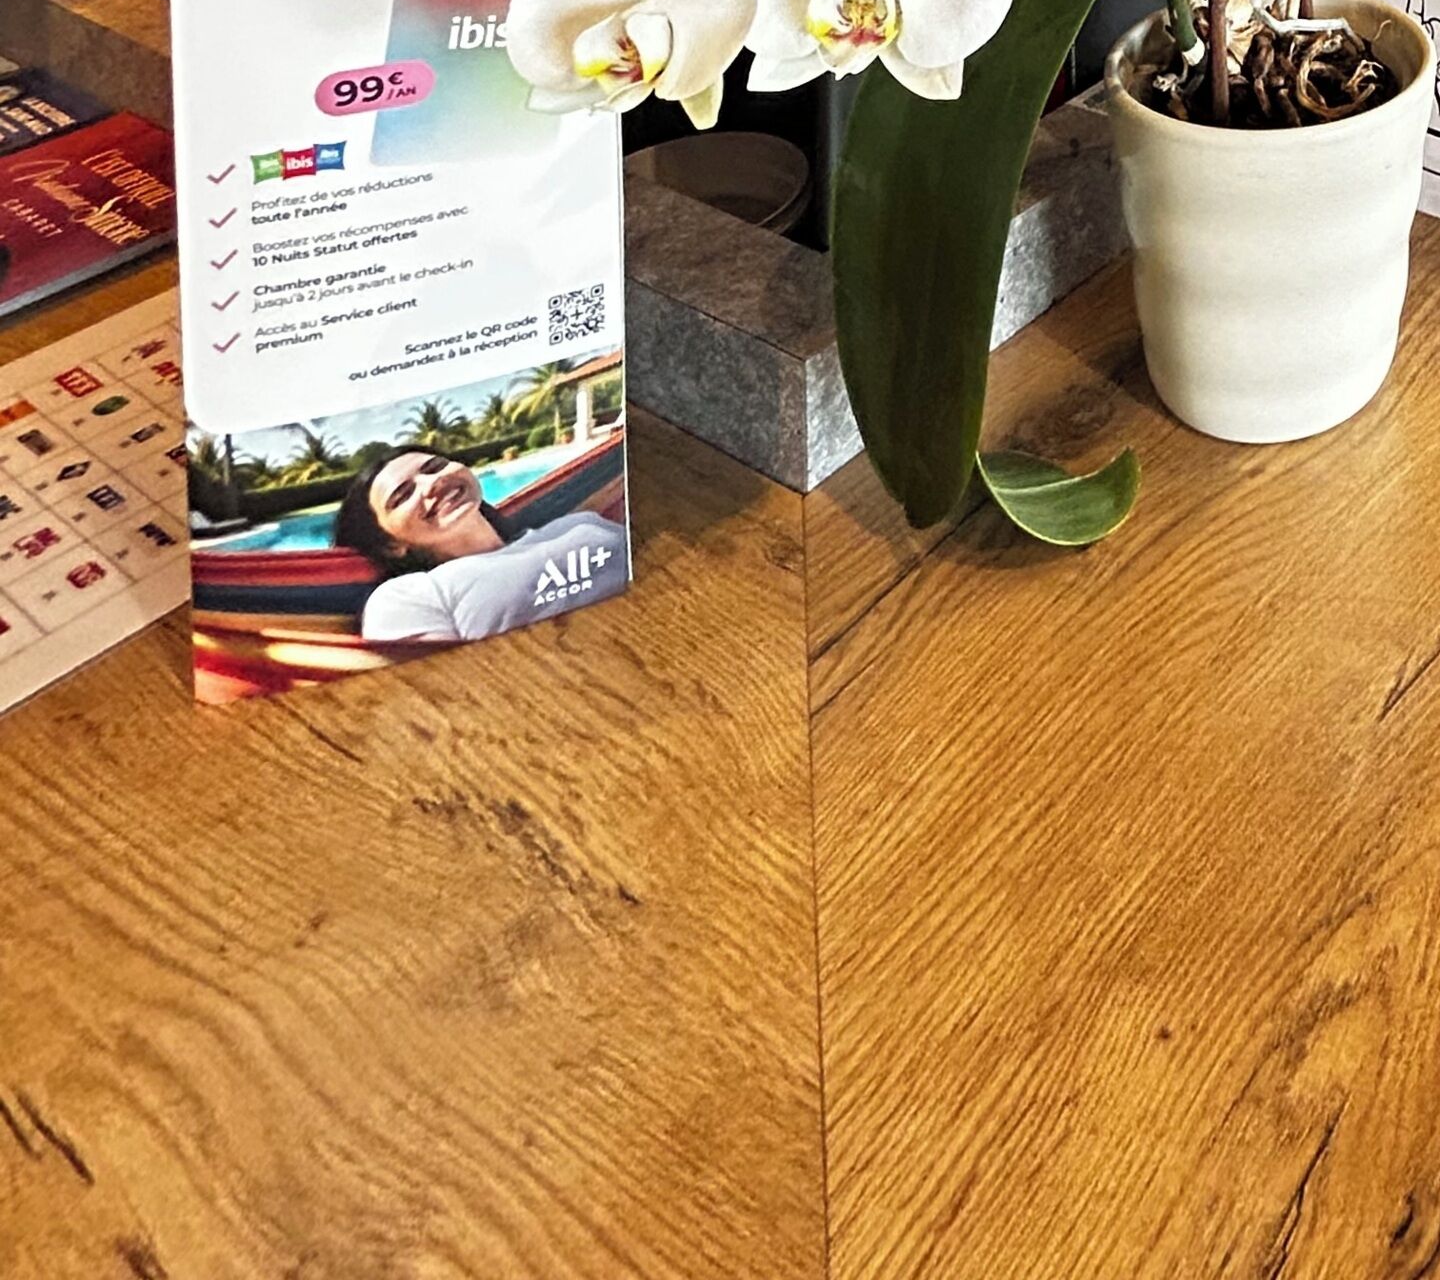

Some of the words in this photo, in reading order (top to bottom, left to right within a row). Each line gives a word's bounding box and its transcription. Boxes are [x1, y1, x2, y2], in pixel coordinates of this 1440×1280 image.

[333, 75, 385, 108] 99
[286, 155, 314, 170] ibis
[251, 195, 307, 213] Profitez
[310, 191, 329, 203] de
[331, 186, 356, 199] vos
[358, 172, 434, 195] réductions
[1, 198, 64, 238] CABARET
[251, 210, 291, 225] toute
[252, 236, 308, 254] Boostez
[312, 231, 337, 244] vos
[339, 212, 434, 240] récompenses
[436, 205, 470, 220] avec
[252, 255, 268, 267] 10
[271, 248, 310, 265] Nuits
[313, 240, 359, 257] Statut
[362, 229, 418, 248] offertes
[253, 276, 321, 296] Chambre
[325, 263, 387, 286] garantie
[308, 290, 316, 301] 2
[317, 281, 355, 302] jours
[357, 275, 396, 292] avant
[399, 271, 412, 282] le
[414, 258, 475, 280] check-in
[254, 322, 297, 338] Accès
[300, 318, 318, 330] au
[320, 308, 374, 326] Service
[377, 298, 418, 315] client
[404, 334, 463, 355] Scannez
[466, 329, 478, 341] le
[481, 323, 502, 338] QR
[505, 315, 538, 331] code
[255, 331, 324, 354] premium
[349, 369, 368, 381] ou
[370, 352, 445, 377] demandez
[448, 348, 456, 359] à
[459, 344, 471, 355] la
[474, 329, 538, 352] réception
[535, 545, 612, 595] All+
[533, 579, 593, 607] ACCOR
